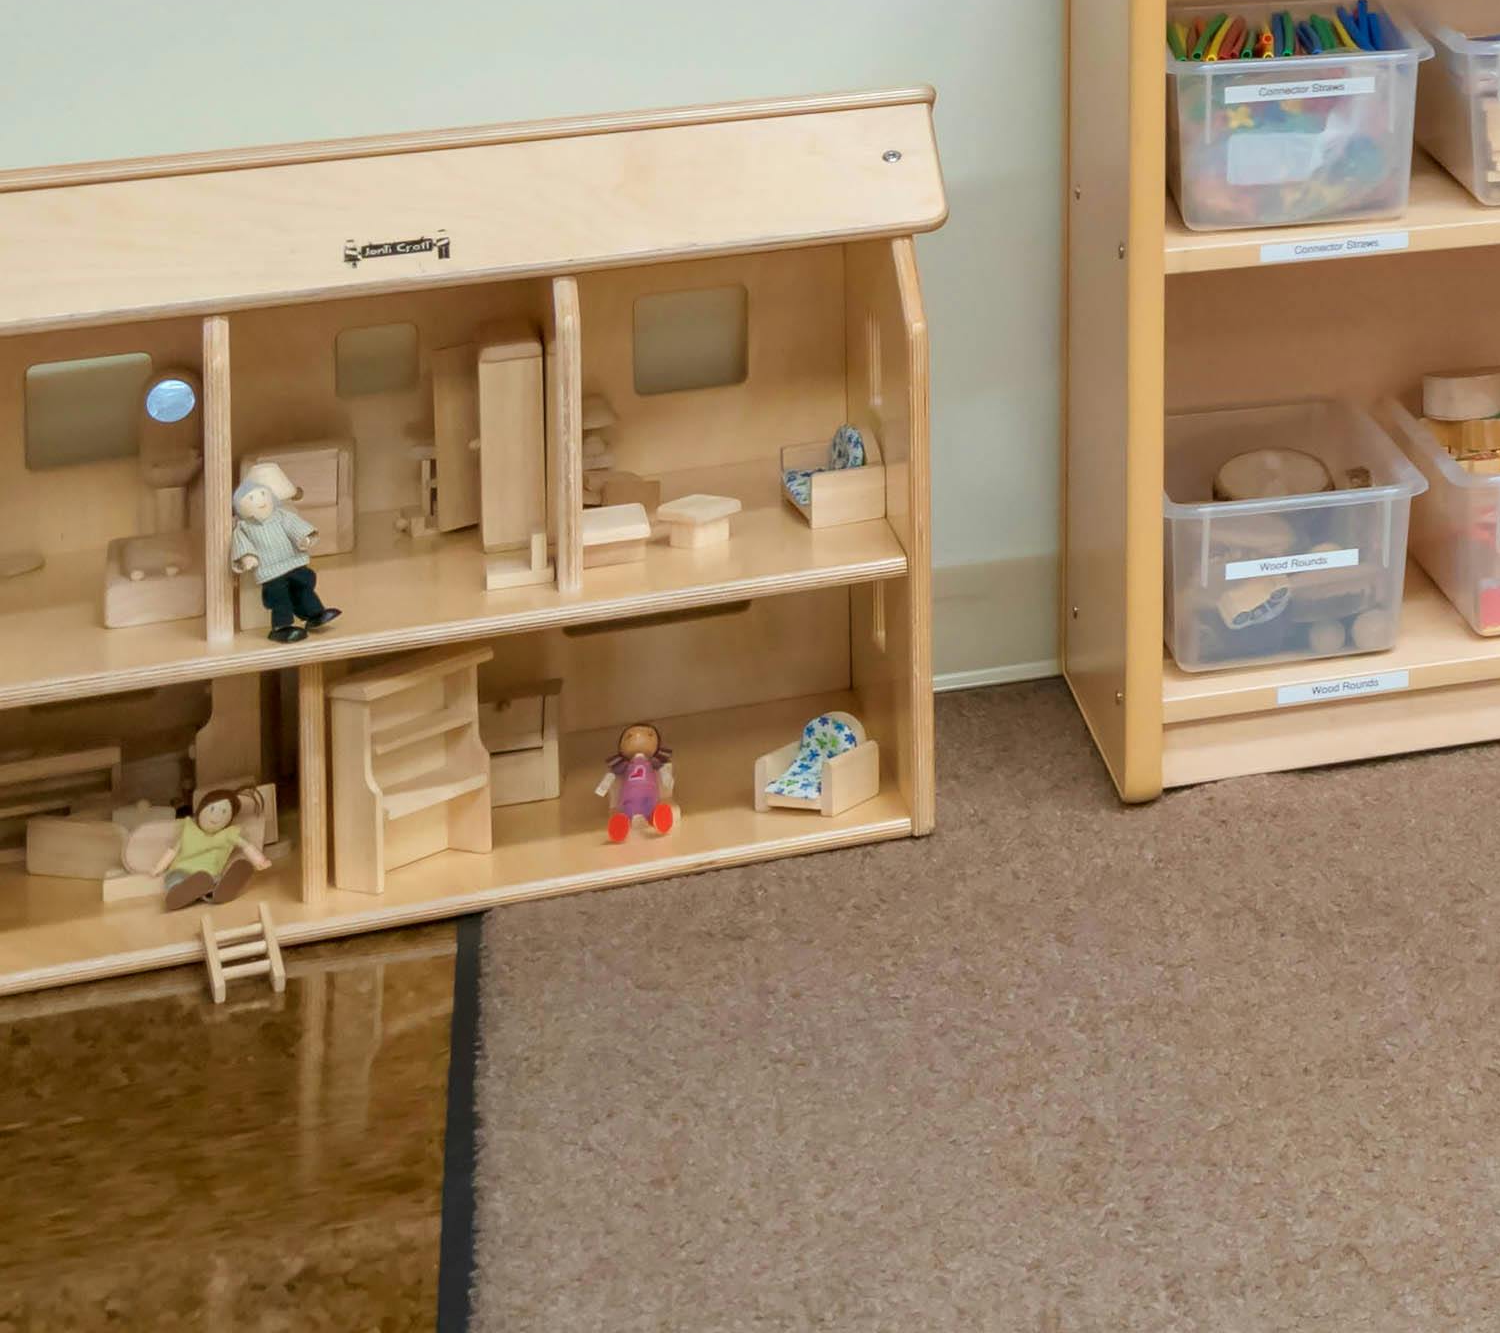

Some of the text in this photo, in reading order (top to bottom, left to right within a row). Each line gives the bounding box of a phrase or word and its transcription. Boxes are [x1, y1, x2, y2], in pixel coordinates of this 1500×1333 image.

[1258, 83, 1346, 97] Connector Straws
[1294, 238, 1379, 255] Connector Straws
[1259, 555, 1328, 572] Wood Rounds
[1311, 678, 1380, 696] Wood Rounds
